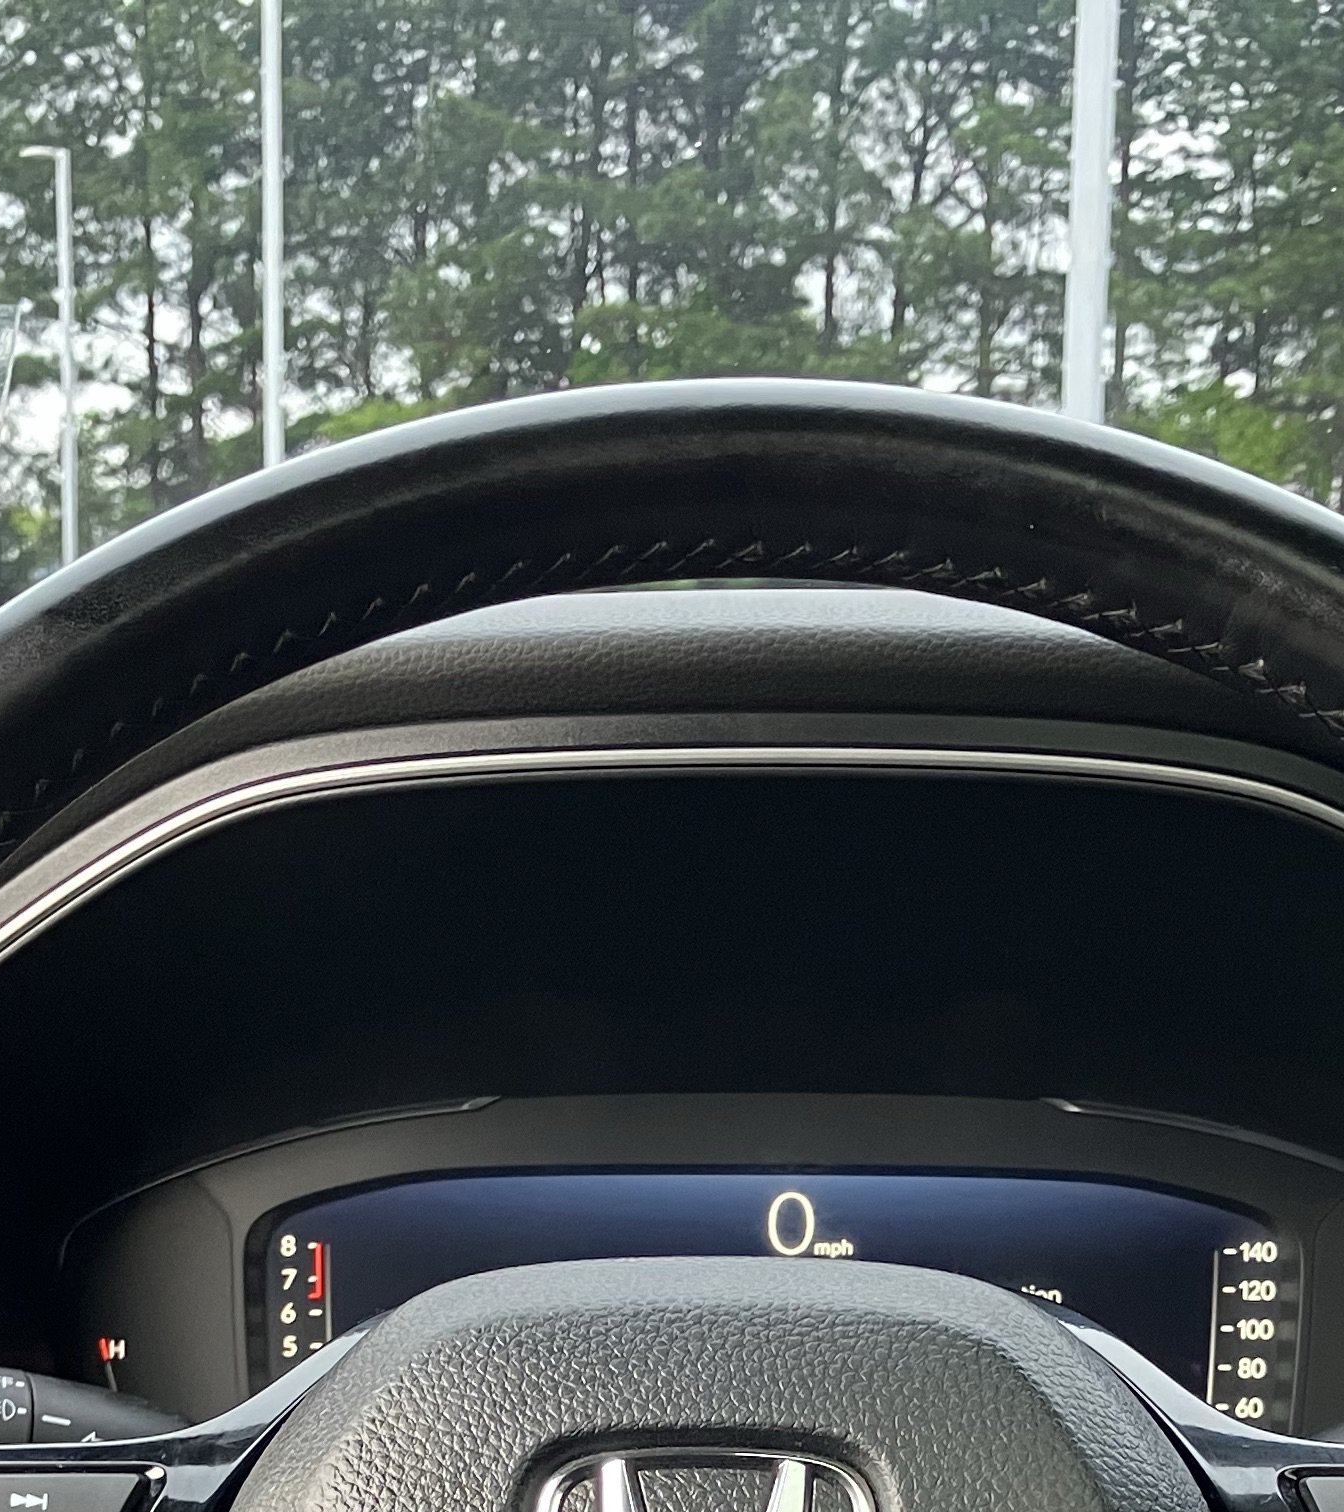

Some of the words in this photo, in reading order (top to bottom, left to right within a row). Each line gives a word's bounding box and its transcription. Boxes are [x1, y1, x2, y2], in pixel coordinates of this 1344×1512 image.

[768, 1191, 815, 1256] 0
[813, 1239, 854, 1258] mph
[280, 1235, 297, 1257] 8
[1239, 1241, 1278, 1262] 140
[281, 1268, 297, 1290] 7
[1238, 1280, 1277, 1302] 120
[280, 1302, 297, 1324] 6
[1236, 1318, 1275, 1341] 100
[108, 1339, 125, 1360] H
[281, 1335, 298, 1357] 5
[1237, 1357, 1268, 1379] 80
[1234, 1397, 1265, 1419] 60
